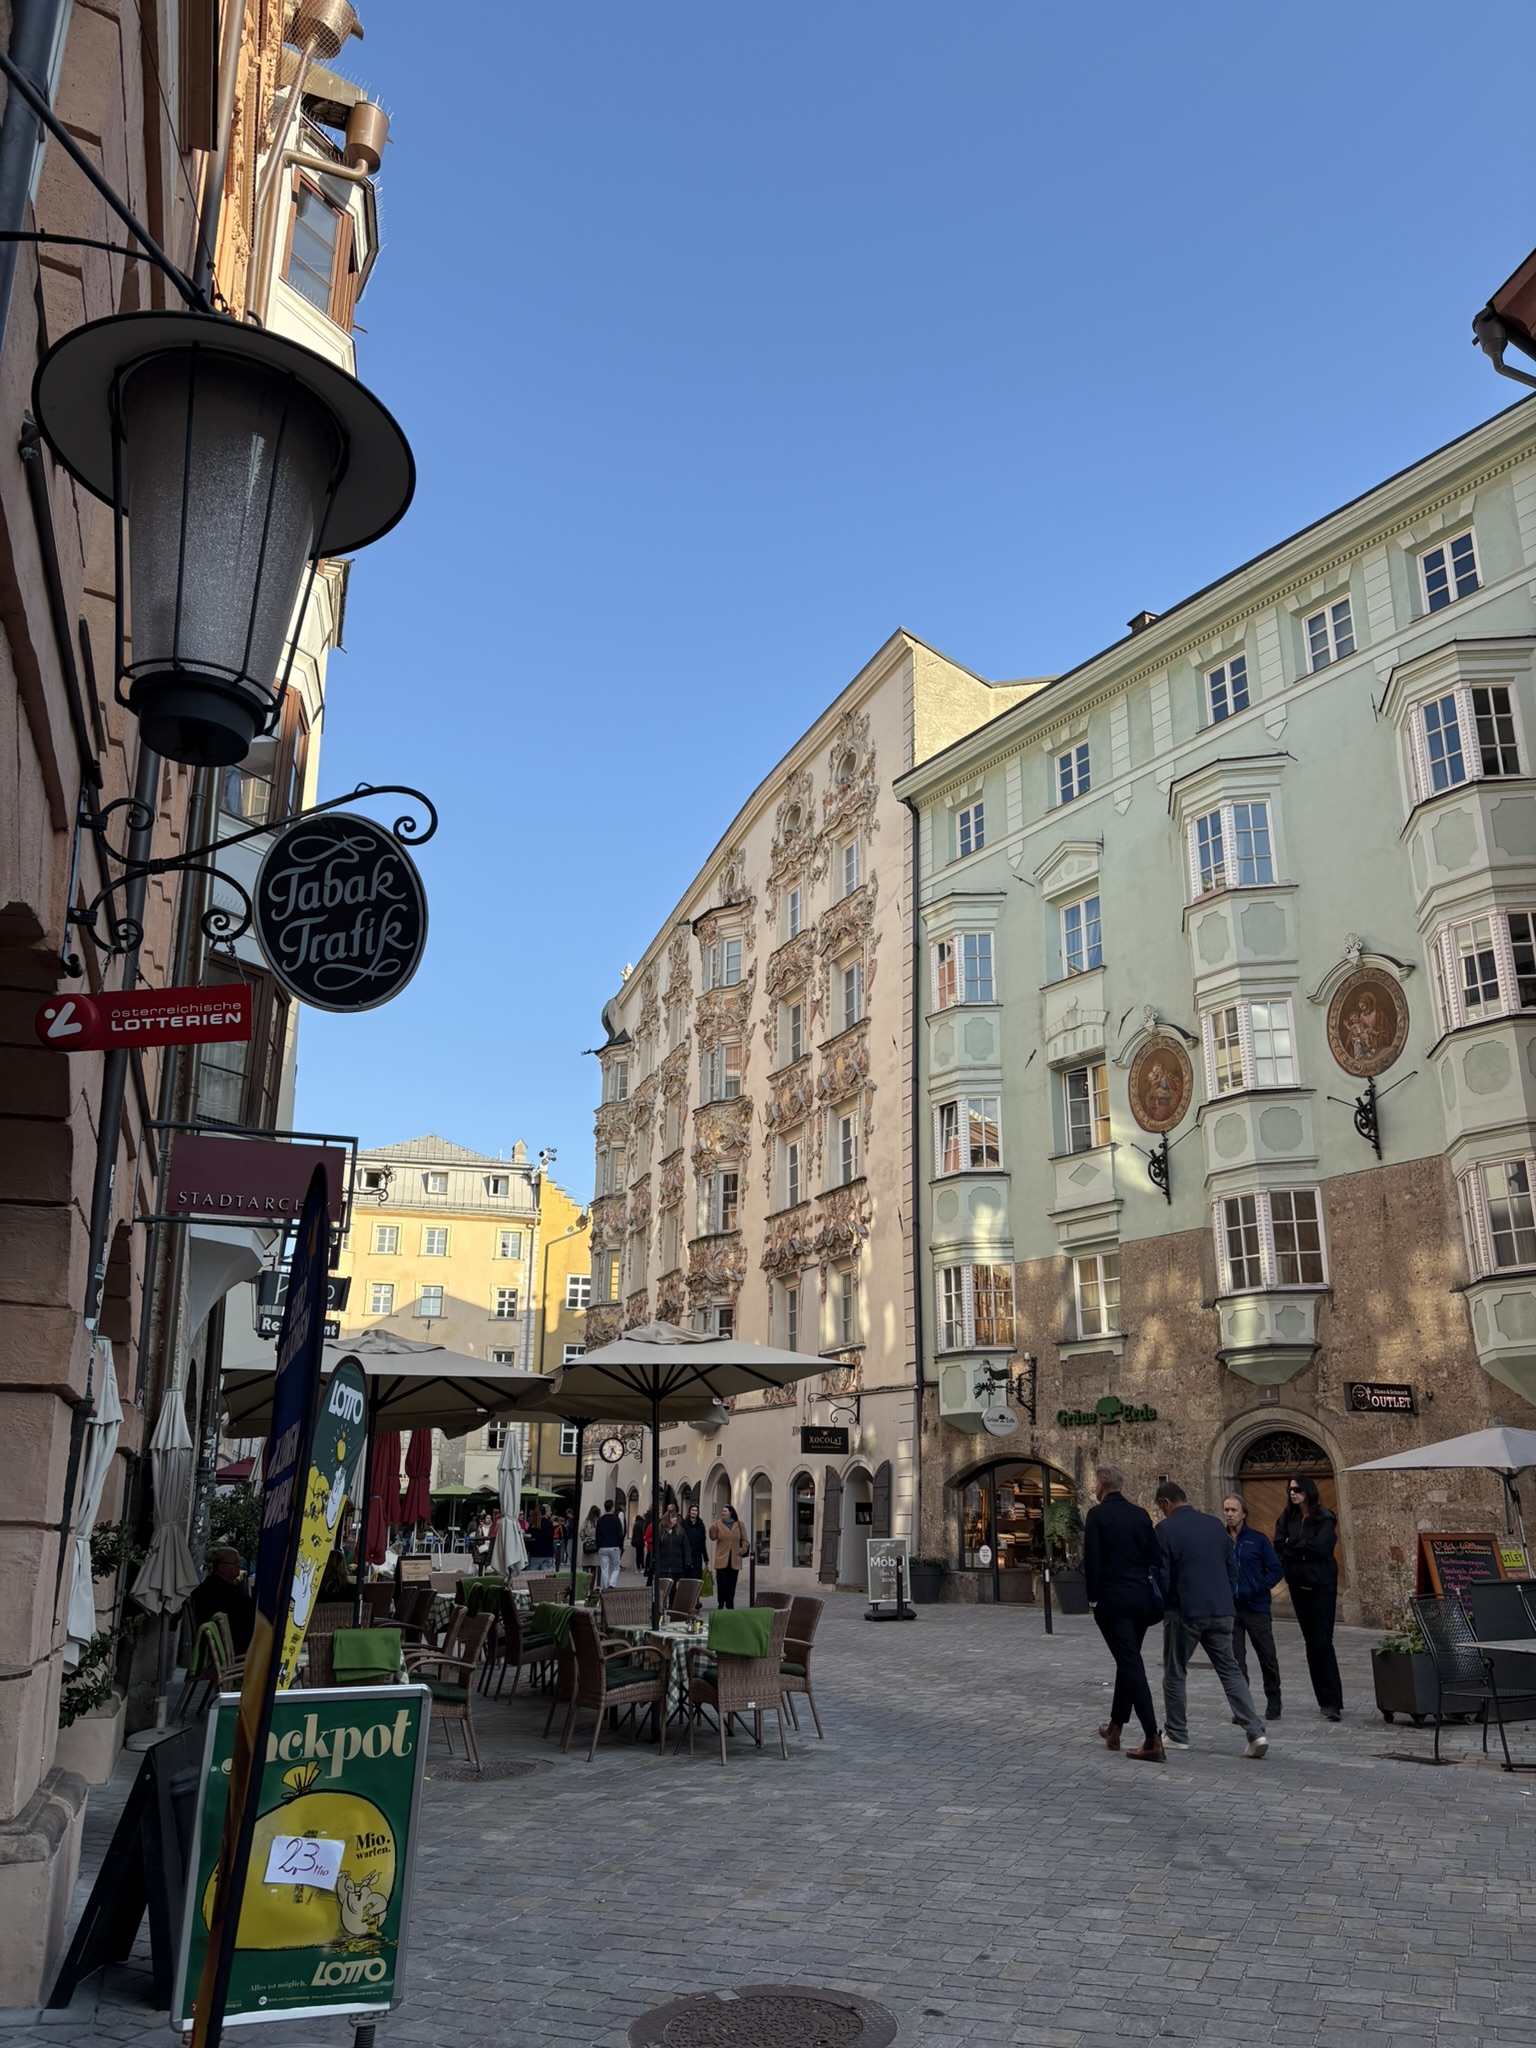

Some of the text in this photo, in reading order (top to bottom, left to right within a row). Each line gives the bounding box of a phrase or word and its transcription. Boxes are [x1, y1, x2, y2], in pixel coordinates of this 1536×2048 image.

[268, 853, 407, 921] Tabak
[279, 904, 416, 972] Trafik
[111, 1001, 242, 1018] österreichische
[111, 1012, 242, 1032] LOTTERIEN
[328, 1379, 364, 1425] LOTTO
[1371, 1395, 1412, 1409] OUTLET
[1056, 1402, 1158, 1426] Grüne Erde
[809, 1436, 843, 1446] XOCOLAT
[870, 1555, 905, 1568] Möbl
[1501, 1553, 1524, 1563] UTLET
[355, 1831, 391, 1850] Mio.
[355, 1847, 391, 1860] warten.
[310, 1957, 387, 1987] LOTTO
[249, 1979, 307, 1992] Alles ist möglich.
